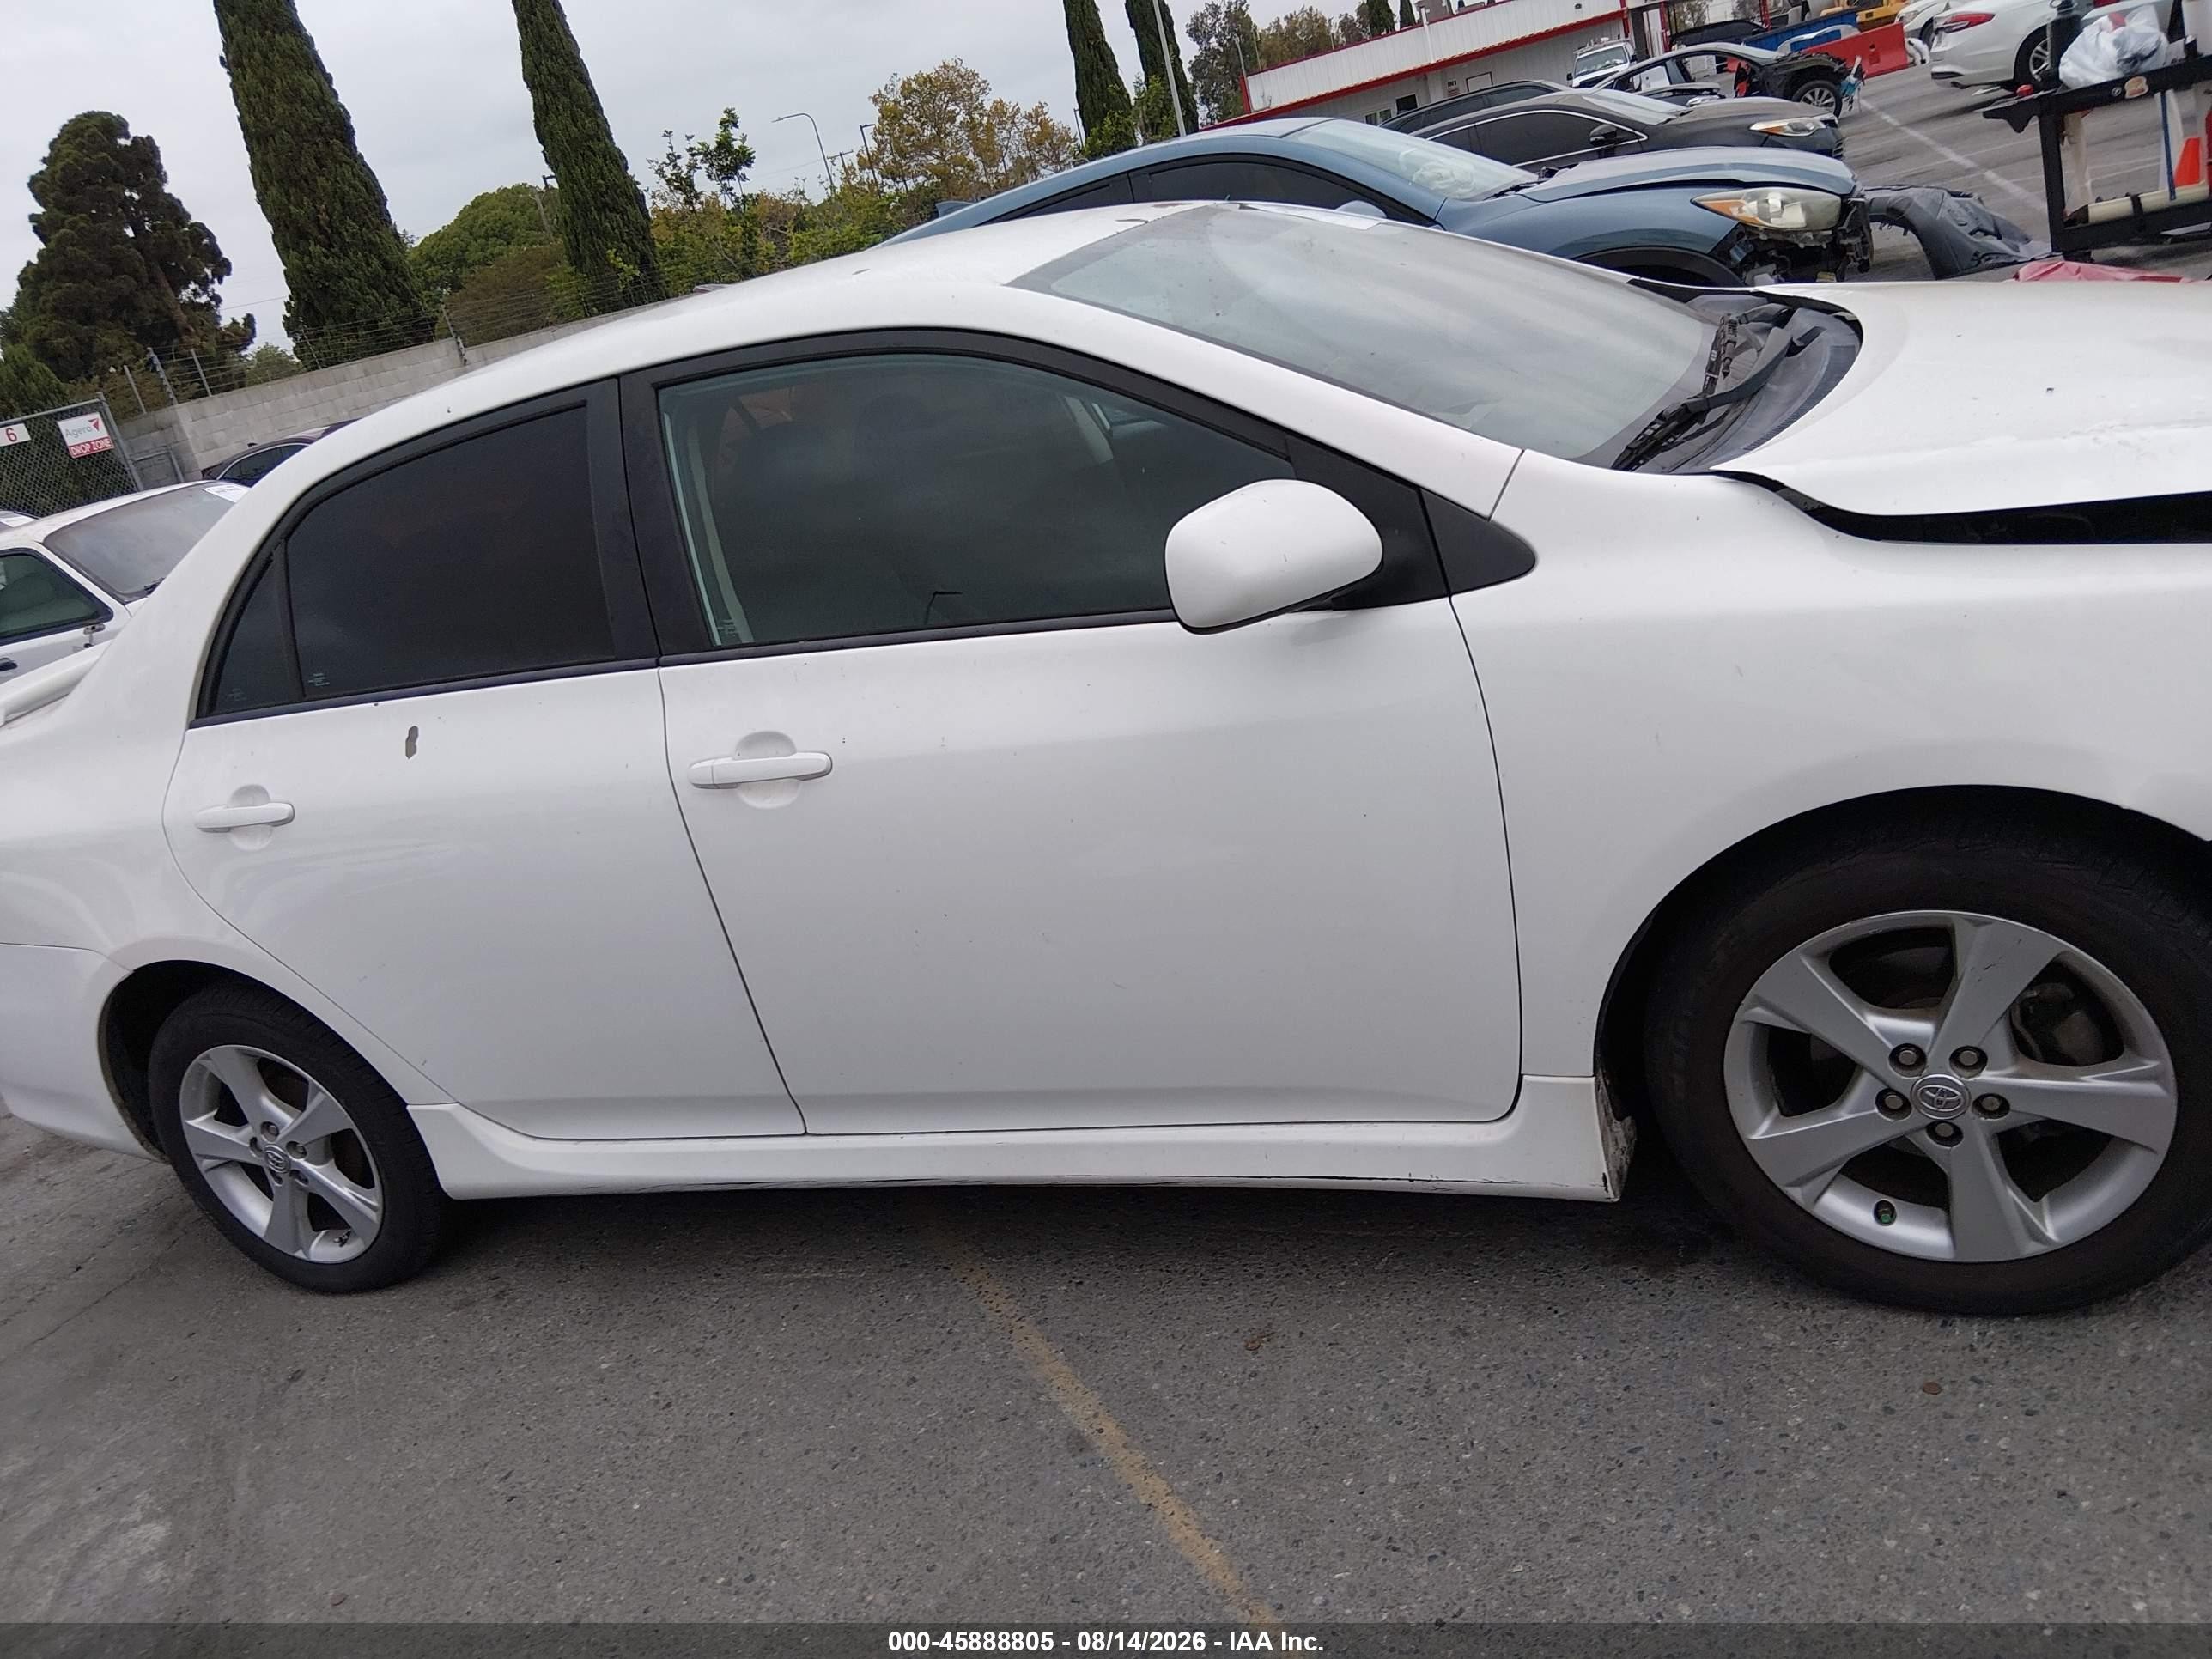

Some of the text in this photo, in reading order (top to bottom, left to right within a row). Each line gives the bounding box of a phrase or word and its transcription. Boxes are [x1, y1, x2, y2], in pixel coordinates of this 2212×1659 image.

[6, 428, 17, 442] 6
[70, 438, 112, 455] DROP ZONE
